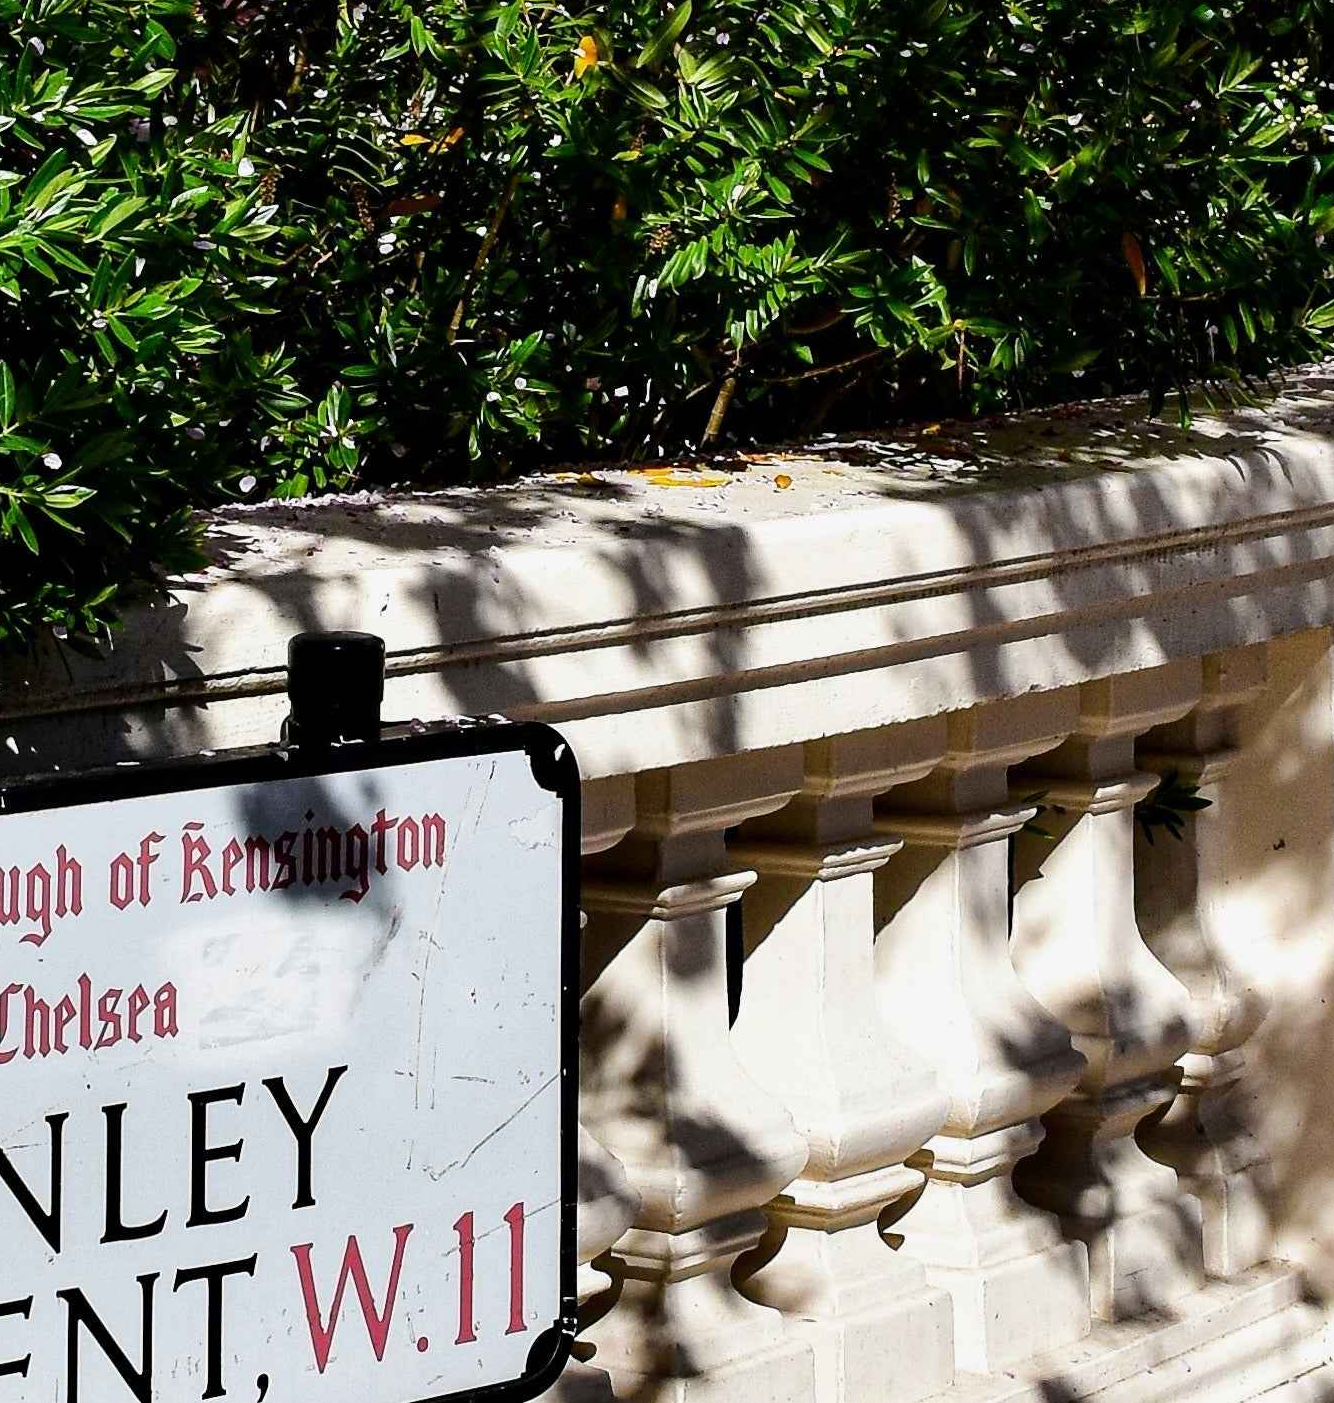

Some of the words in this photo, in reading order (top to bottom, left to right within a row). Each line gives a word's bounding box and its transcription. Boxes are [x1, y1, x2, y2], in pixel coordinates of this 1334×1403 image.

[109, 831, 167, 911] of
[180, 802, 447, 904] Kensington
[290, 1202, 529, 1374] W.11
